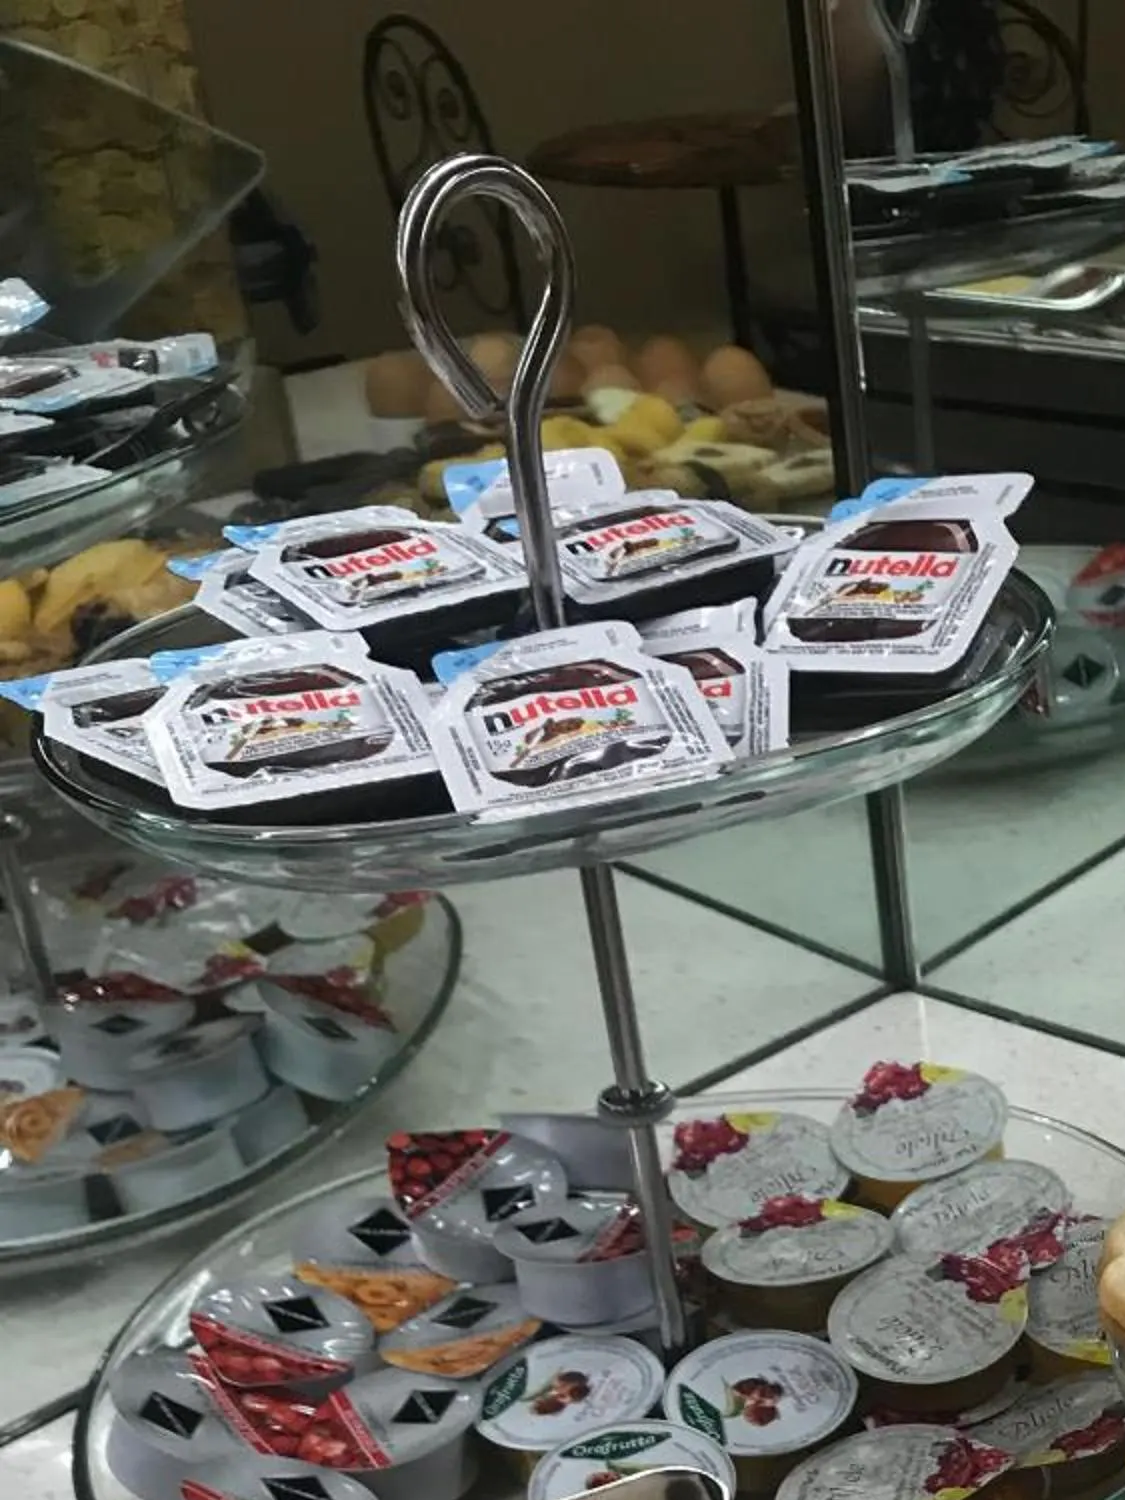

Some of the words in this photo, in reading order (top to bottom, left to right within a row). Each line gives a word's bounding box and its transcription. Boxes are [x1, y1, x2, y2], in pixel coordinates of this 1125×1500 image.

[565, 513, 696, 555] nutella
[303, 538, 440, 579] nutella
[824, 554, 960, 578] nutella
[482, 685, 639, 737] nutella
